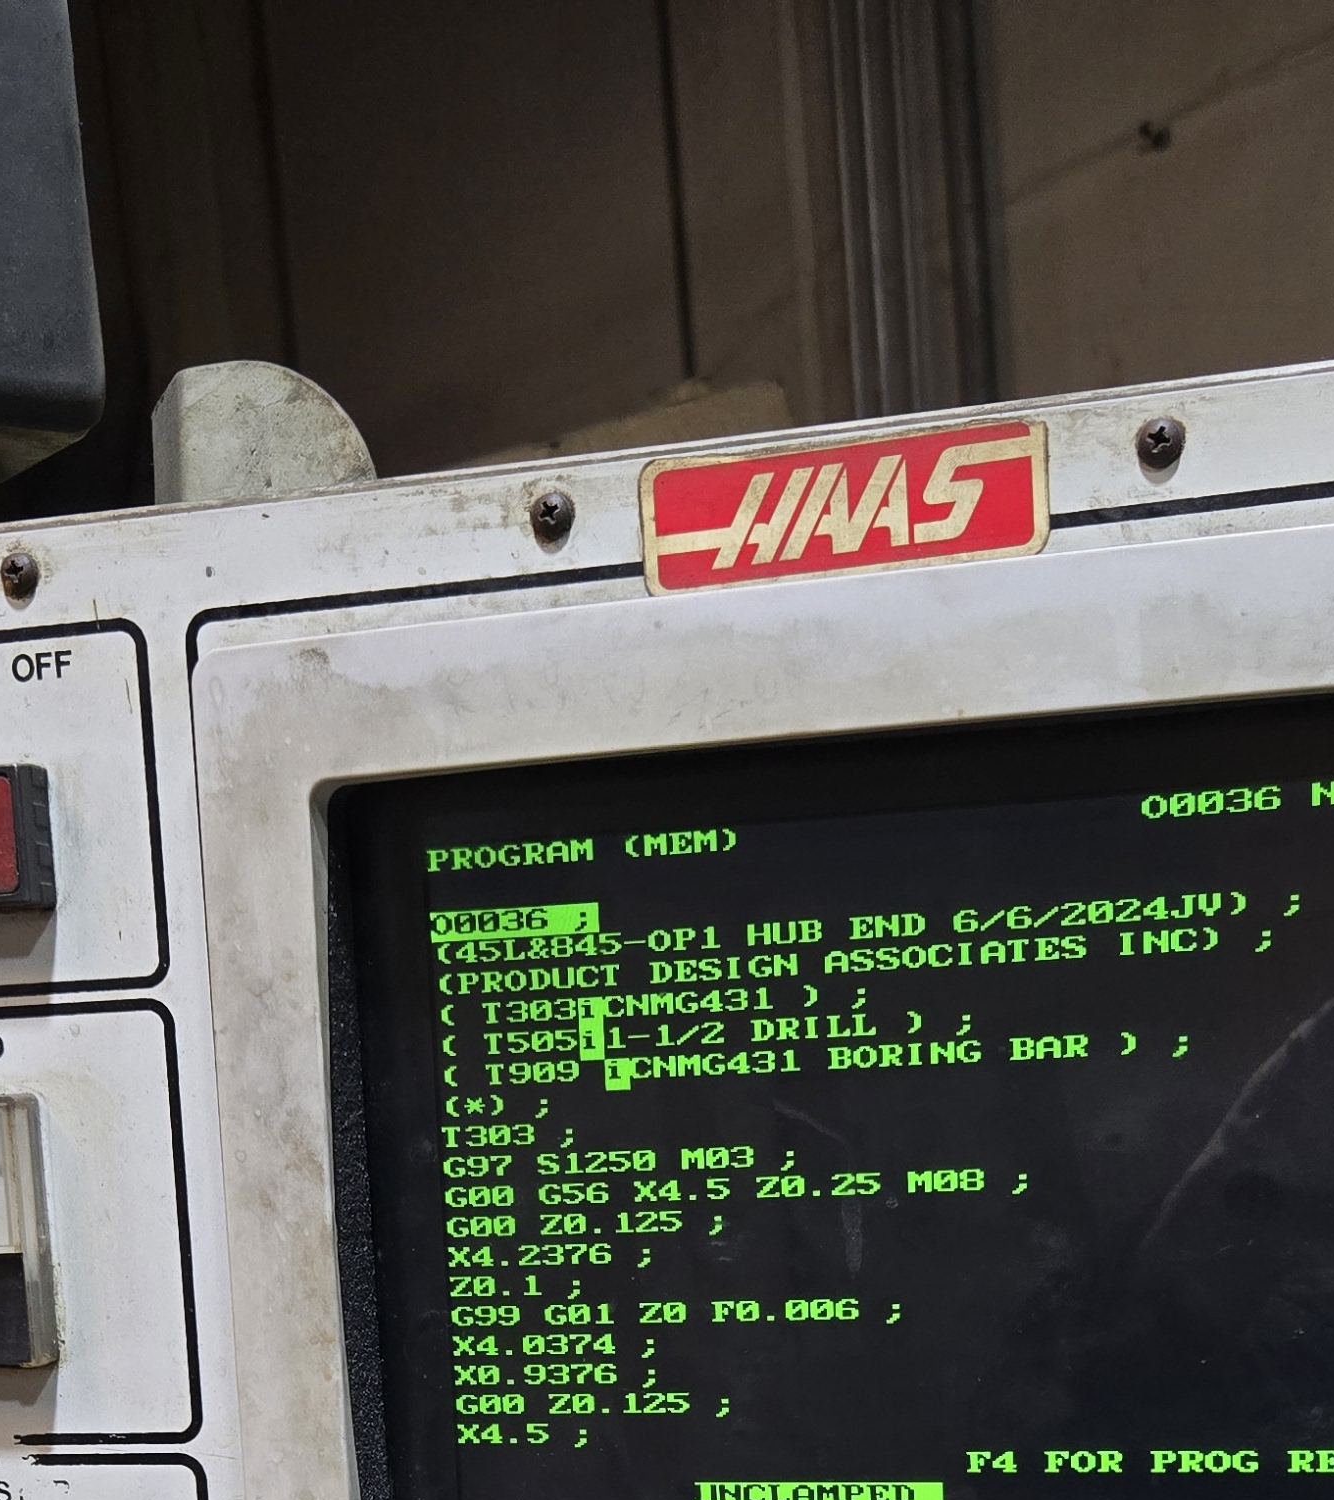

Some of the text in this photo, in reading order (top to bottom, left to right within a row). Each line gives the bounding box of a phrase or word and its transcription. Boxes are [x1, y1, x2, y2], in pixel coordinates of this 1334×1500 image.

[656, 435, 1032, 570] HAAS
[11, 650, 72, 682] OFF
[427, 829, 736, 871] PROGRAM (MEM)
[747, 920, 822, 946] HUB
[849, 913, 925, 939] END
[953, 892, 1247, 934] 6/6/2024JV)
[439, 927, 1218, 995] (PRODUCT DESIGN ASSOCIATES INC)
[751, 1014, 876, 1041] DRILL
[485, 1060, 579, 1085] T909
[828, 1040, 981, 1069] BORING
[1009, 1034, 1088, 1060] BAR
[442, 1124, 535, 1147] T303
[443, 1146, 754, 1177] G97 S1250 M03
[445, 1169, 984, 1207] G00 G56 X4.5 Z0.25 M08
[447, 1211, 682, 1237] G00 Z0.125
[448, 1243, 611, 1267] X4.2376
[450, 1275, 541, 1297] Z0.1
[451, 1298, 859, 1326] G99 G01 Z0 F0.006
[453, 1334, 615, 1356] X4.0374
[454, 1364, 617, 1385] X0.9376
[456, 1393, 690, 1414] G00 Z0.125
[457, 1424, 549, 1443] X4.5
[967, 1451, 1017, 1473] F4
[1044, 1451, 1123, 1473] FOR
[1150, 1451, 1258, 1473] PROG
